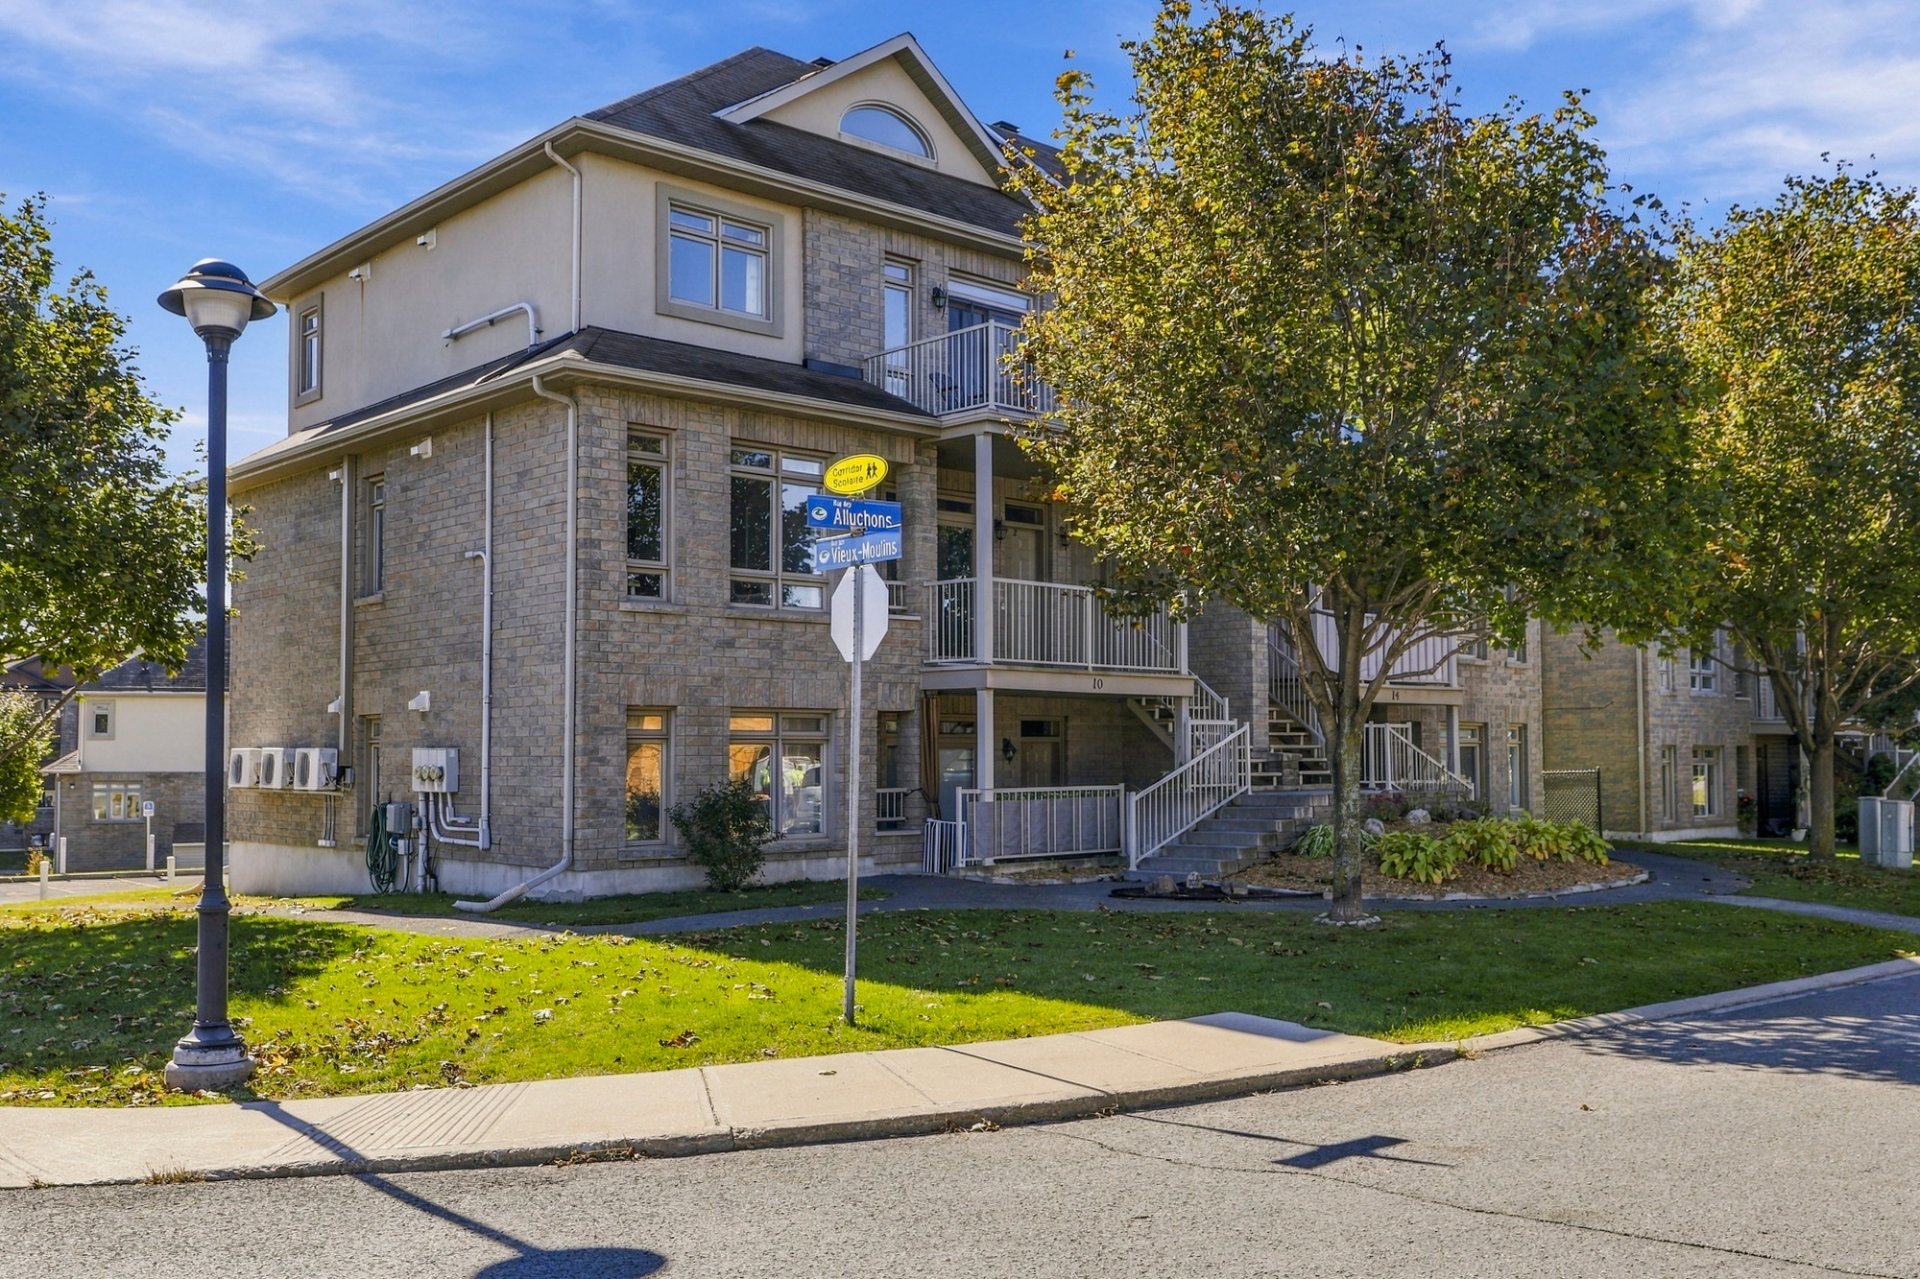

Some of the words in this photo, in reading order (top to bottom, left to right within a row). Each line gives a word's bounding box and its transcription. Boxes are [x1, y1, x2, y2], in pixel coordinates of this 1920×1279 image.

[832, 464, 863, 477] Corridor
[833, 475, 864, 489] Scolaire
[833, 508, 892, 528] Alluchons
[831, 540, 898, 563] Vieux-Moulins
[1093, 677, 1103, 690] 10
[1392, 690, 1400, 701] 14
